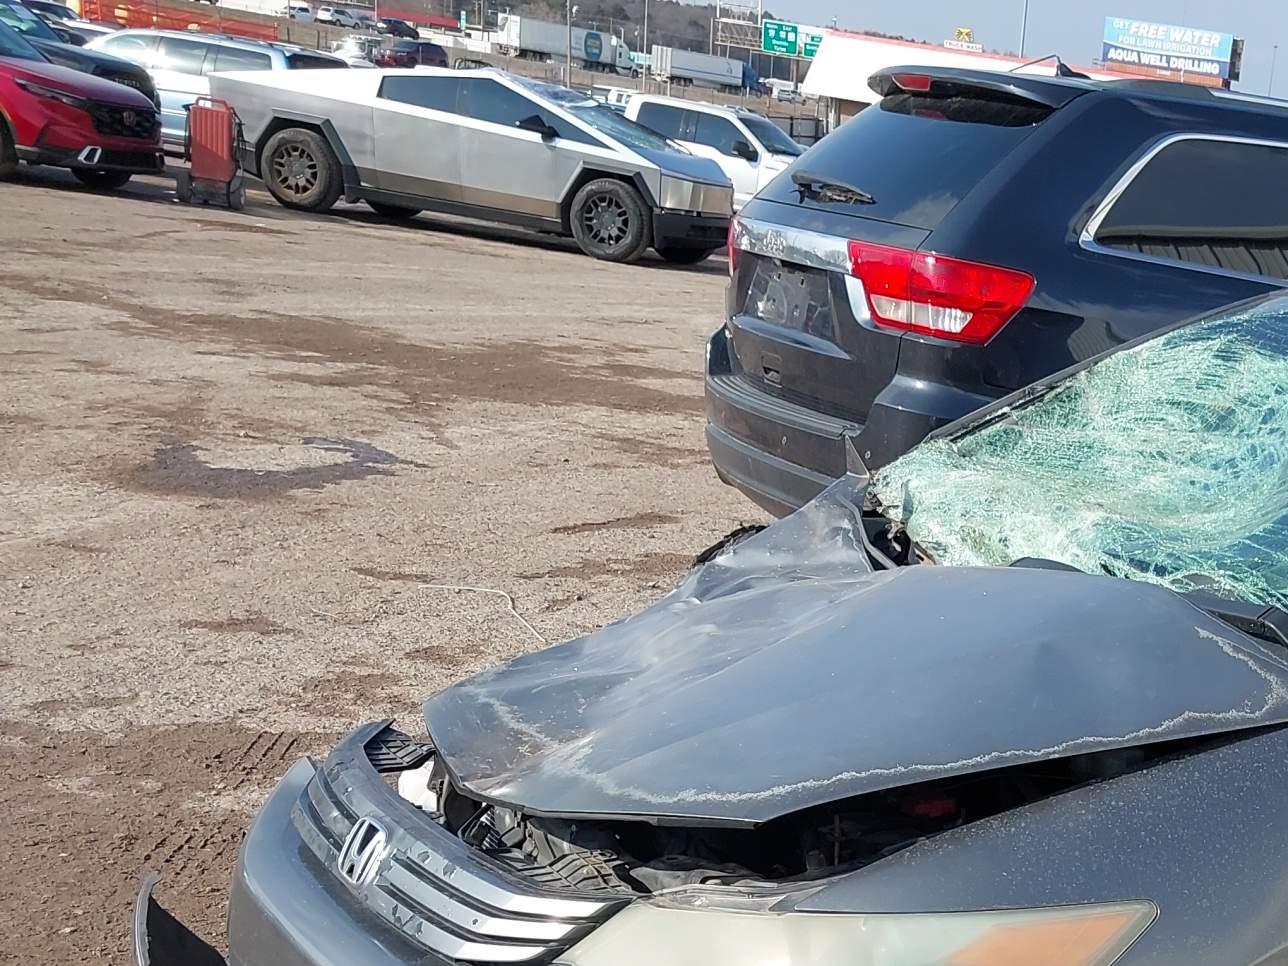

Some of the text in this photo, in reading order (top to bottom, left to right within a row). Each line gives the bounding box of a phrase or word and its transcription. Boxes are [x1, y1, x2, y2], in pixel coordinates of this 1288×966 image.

[1118, 35, 1212, 56] FOR LAWN IRRIGATION
[1130, 23, 1167, 39] FREE
[1171, 29, 1221, 47] WATER
[1108, 48, 1139, 62] AQUA
[1140, 52, 1169, 67] WELL
[1171, 59, 1220, 74] DRILLING
